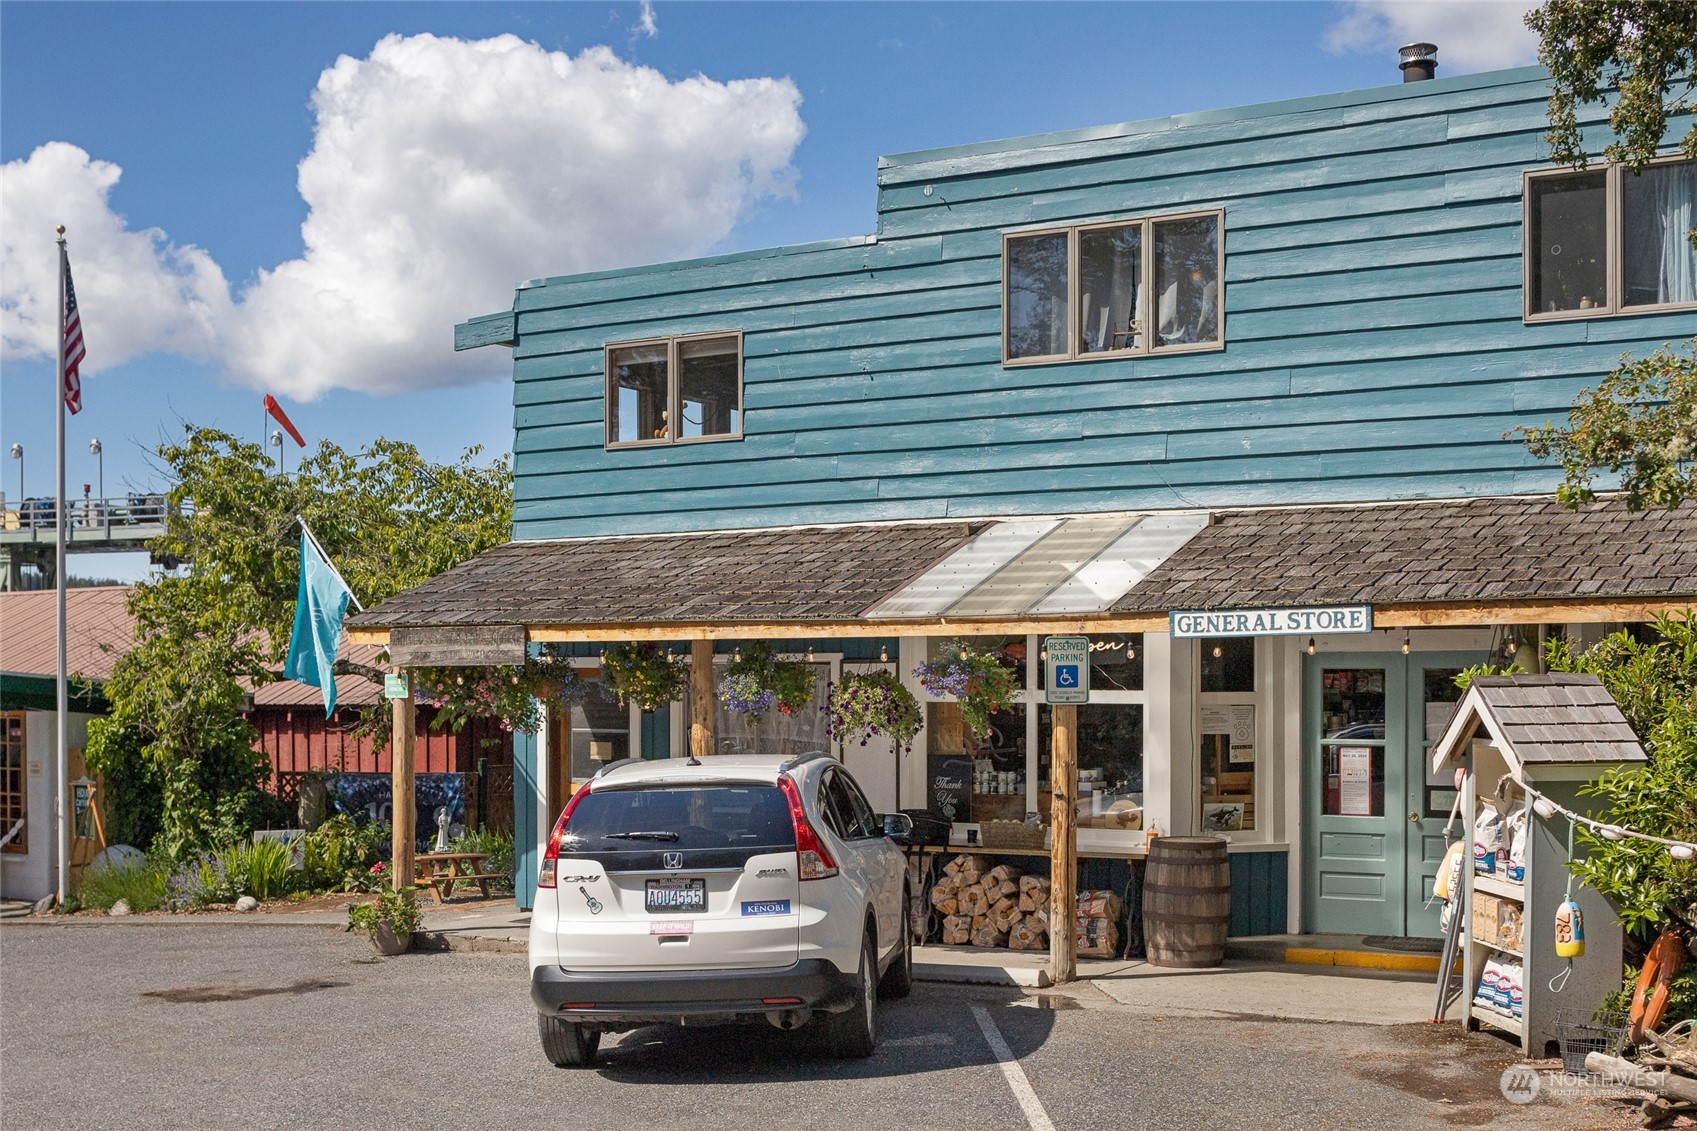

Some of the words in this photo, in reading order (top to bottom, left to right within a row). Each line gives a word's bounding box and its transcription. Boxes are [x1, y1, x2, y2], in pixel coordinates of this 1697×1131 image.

[1177, 613, 1283, 633] GENERAL
[1287, 610, 1363, 630] STORE
[1049, 642, 1086, 651] RESERVED
[1051, 653, 1084, 662] PARKING
[934, 776, 962, 790] Thank
[936, 790, 958, 807] You
[747, 904, 784, 913] KENOBI
[1556, 912, 1572, 943] 783
